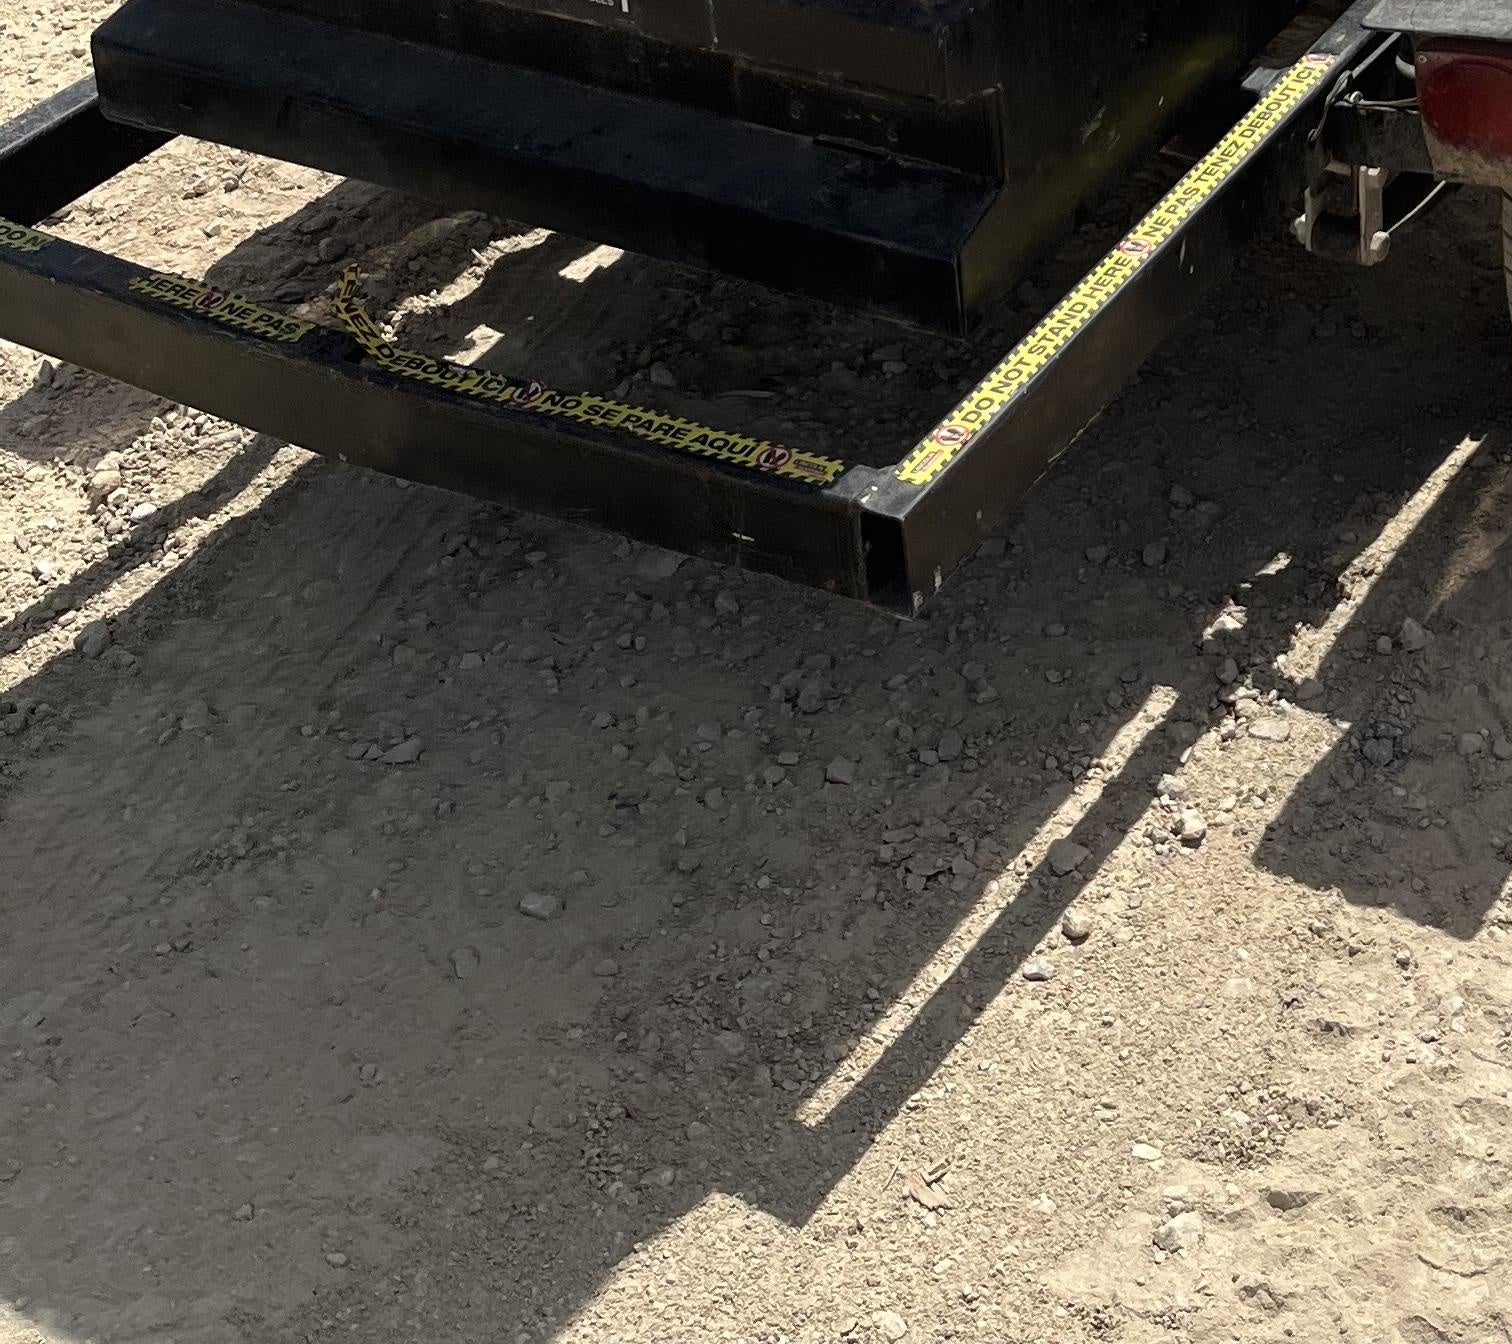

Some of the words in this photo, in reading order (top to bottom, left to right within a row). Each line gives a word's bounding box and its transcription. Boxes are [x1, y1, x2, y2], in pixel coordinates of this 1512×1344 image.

[1142, 217, 1169, 239] NE
[1169, 187, 1200, 216] PAS
[1195, 139, 1245, 185] TENEZ
[1240, 83, 1297, 139] DEBOUT
[1294, 64, 1318, 89] ICI
[221, 301, 255, 320] NE
[251, 310, 301, 336] PAS
[961, 396, 995, 425] DO
[991, 357, 1031, 396] NOT
[1028, 301, 1088, 356] STAND
[1087, 255, 1133, 298] HERE
[543, 393, 582, 410] NO
[582, 404, 623, 422] SE
[619, 415, 690, 442] PARE
